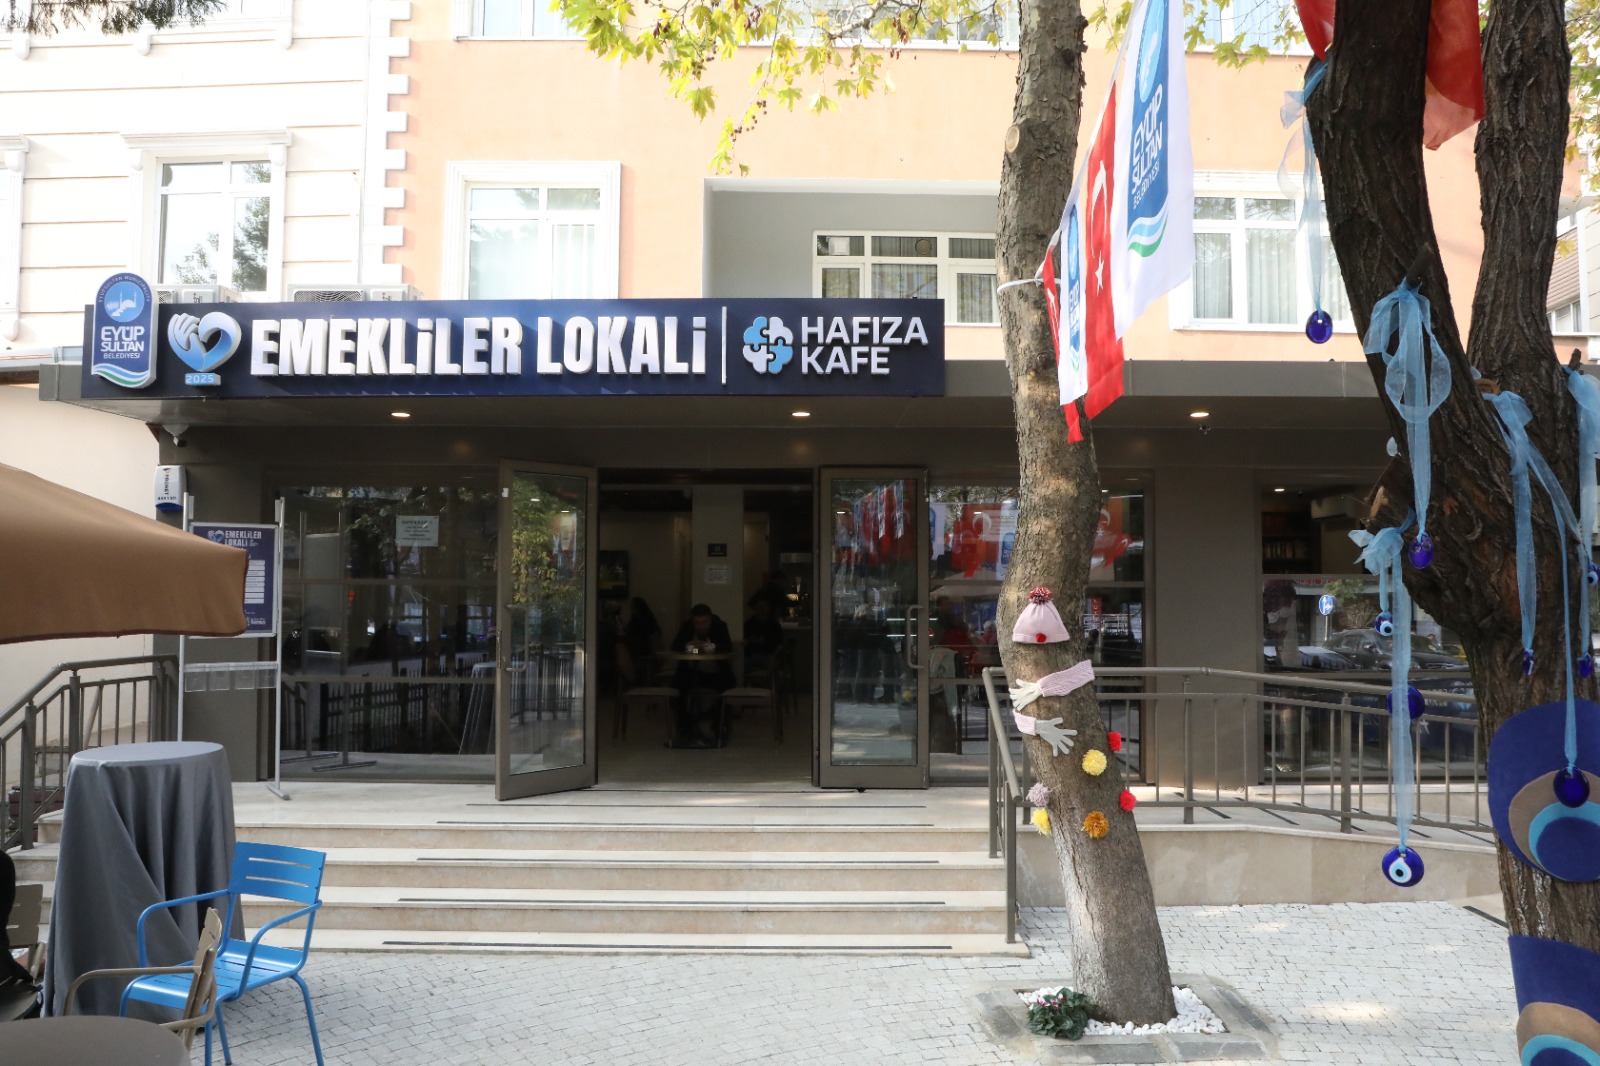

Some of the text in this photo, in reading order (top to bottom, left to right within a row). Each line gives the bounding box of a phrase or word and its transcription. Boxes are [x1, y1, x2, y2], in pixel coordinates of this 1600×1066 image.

[1131, 121, 1163, 194] SULTAN
[101, 326, 145, 341] EYÜP
[801, 316, 928, 345] HAFIZA
[101, 341, 145, 352] SULTAN
[801, 346, 890, 374] KAFE
[186, 374, 215, 384] 2025
